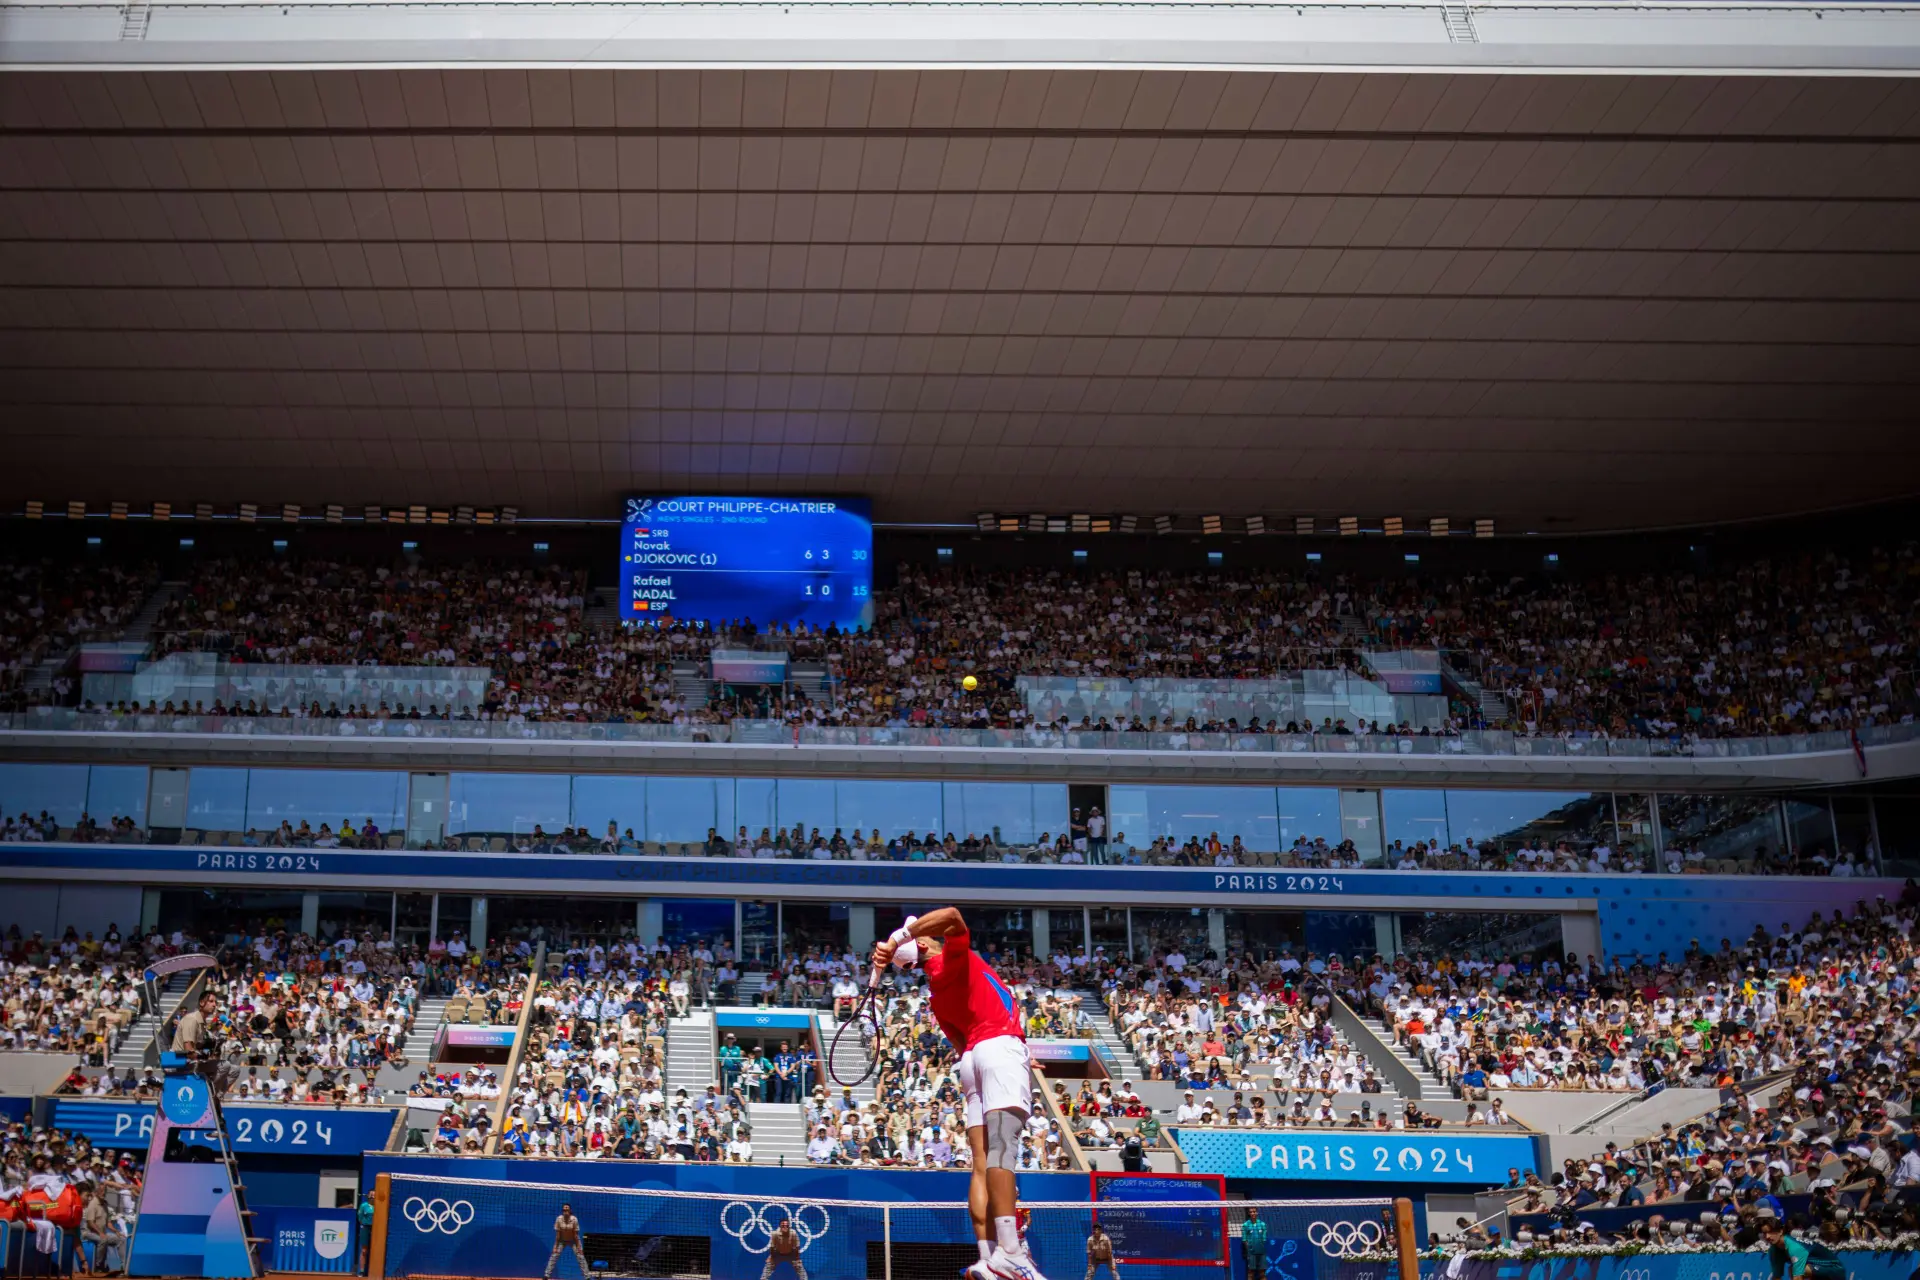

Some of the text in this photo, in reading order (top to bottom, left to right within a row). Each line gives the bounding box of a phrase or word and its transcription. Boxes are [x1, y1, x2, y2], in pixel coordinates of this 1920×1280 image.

[657, 501, 836, 514] COURT PHILIPPE-CHATRIER
[652, 529, 669, 537] SRB
[634, 540, 670, 551] Novak
[633, 552, 717, 565] DJOKOVIC (1)
[804, 549, 868, 560] 6 3 30
[633, 575, 671, 586] Rafael
[633, 589, 677, 600] NADAL
[805, 584, 869, 596] 1 0 15
[650, 601, 669, 611] ESP
[265, 855, 320, 871] 2024
[1286, 876, 1344, 892] 2024
[235, 1118, 332, 1146] 2024
[1372, 1147, 1474, 1173] 2024
[1113, 1179, 1137, 1187] COURT
[279, 1239, 305, 1247] 2024
[321, 1233, 337, 1242] ITF
